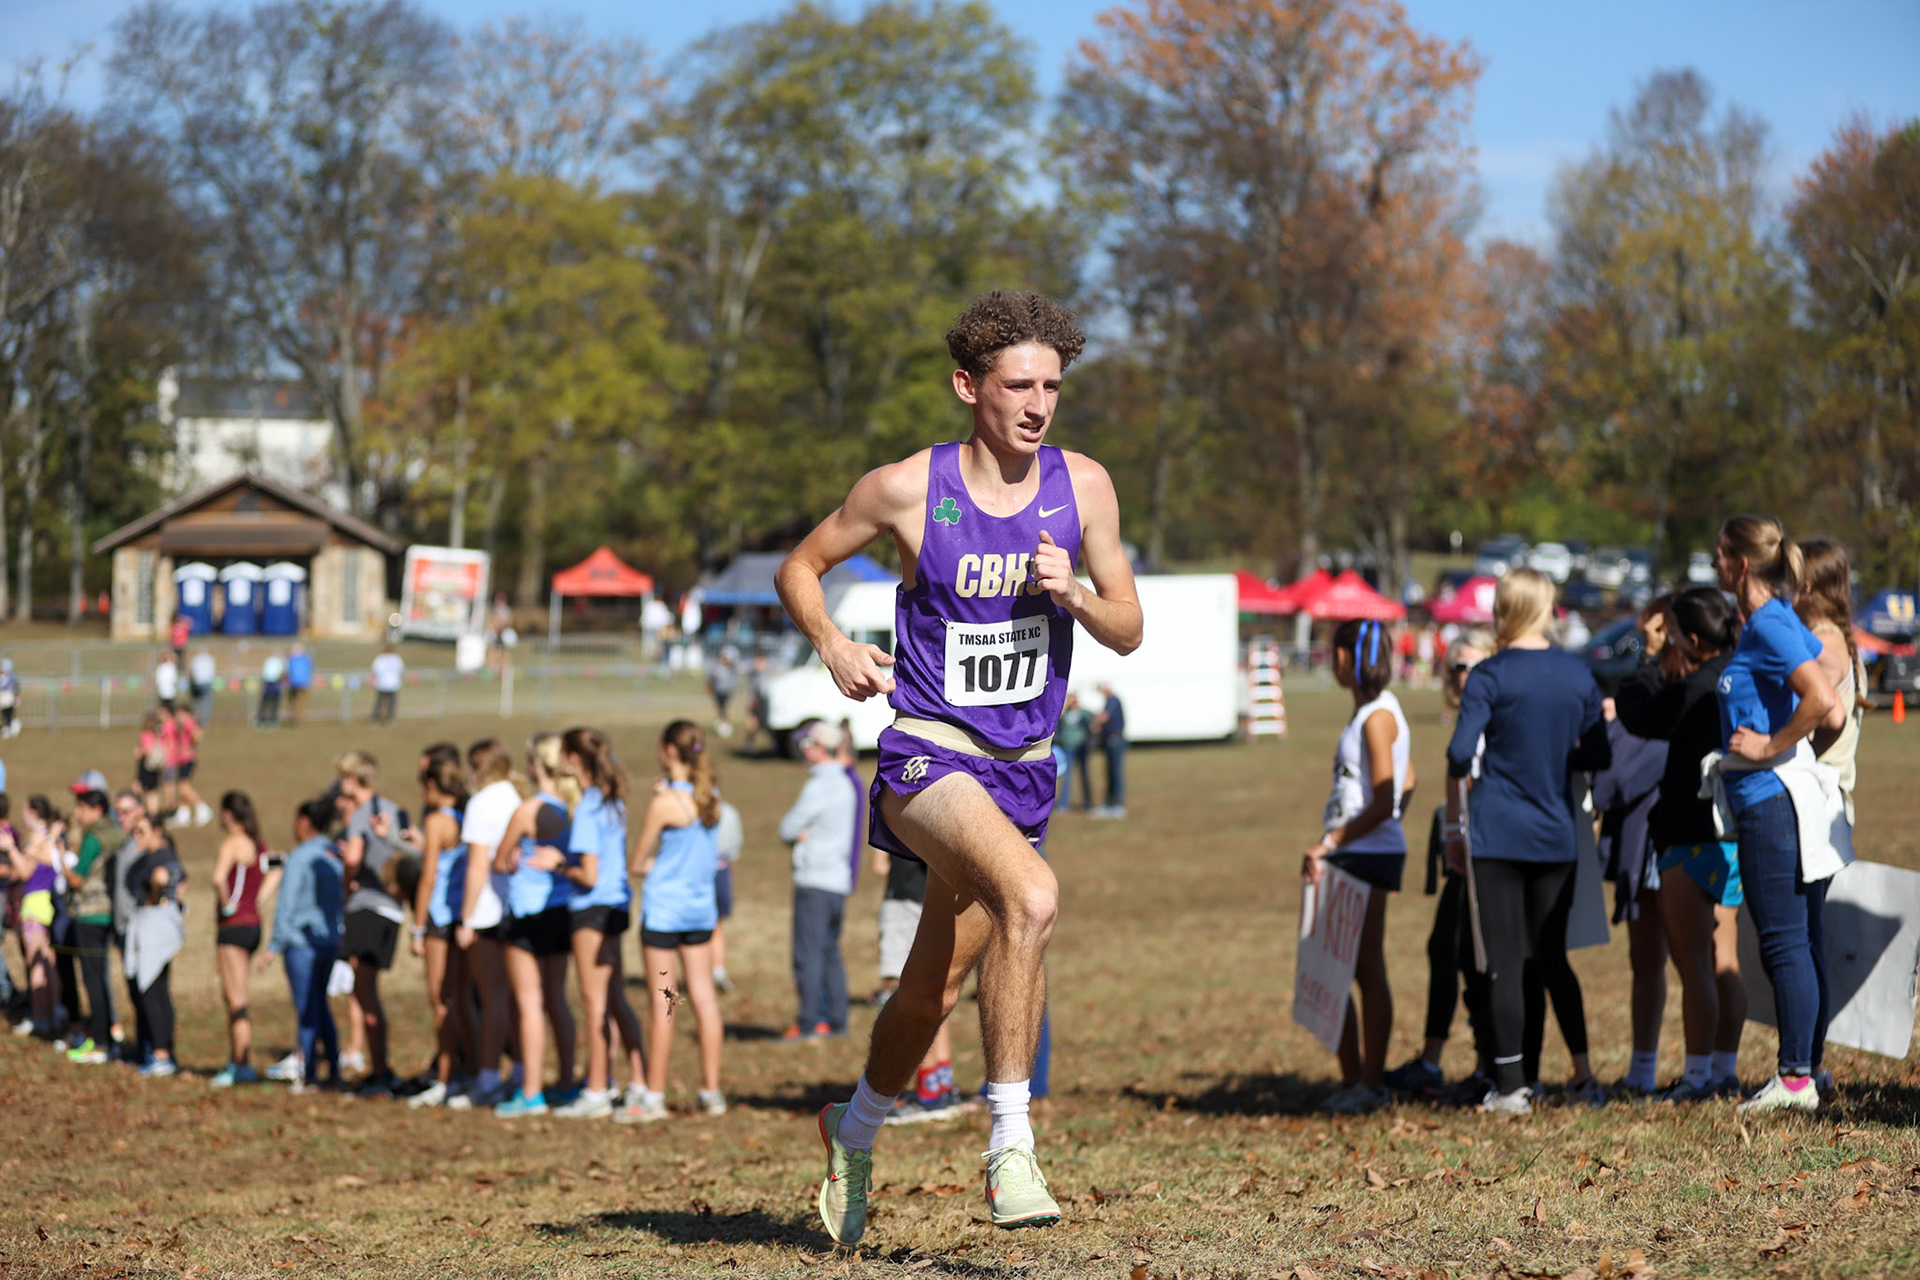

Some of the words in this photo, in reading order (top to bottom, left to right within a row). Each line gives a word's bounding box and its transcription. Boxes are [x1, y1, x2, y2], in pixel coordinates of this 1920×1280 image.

[958, 633, 997, 646] TMSAA
[998, 630, 1027, 644] STATE
[1028, 626, 1041, 639] XC
[958, 648, 1038, 692] 1077
